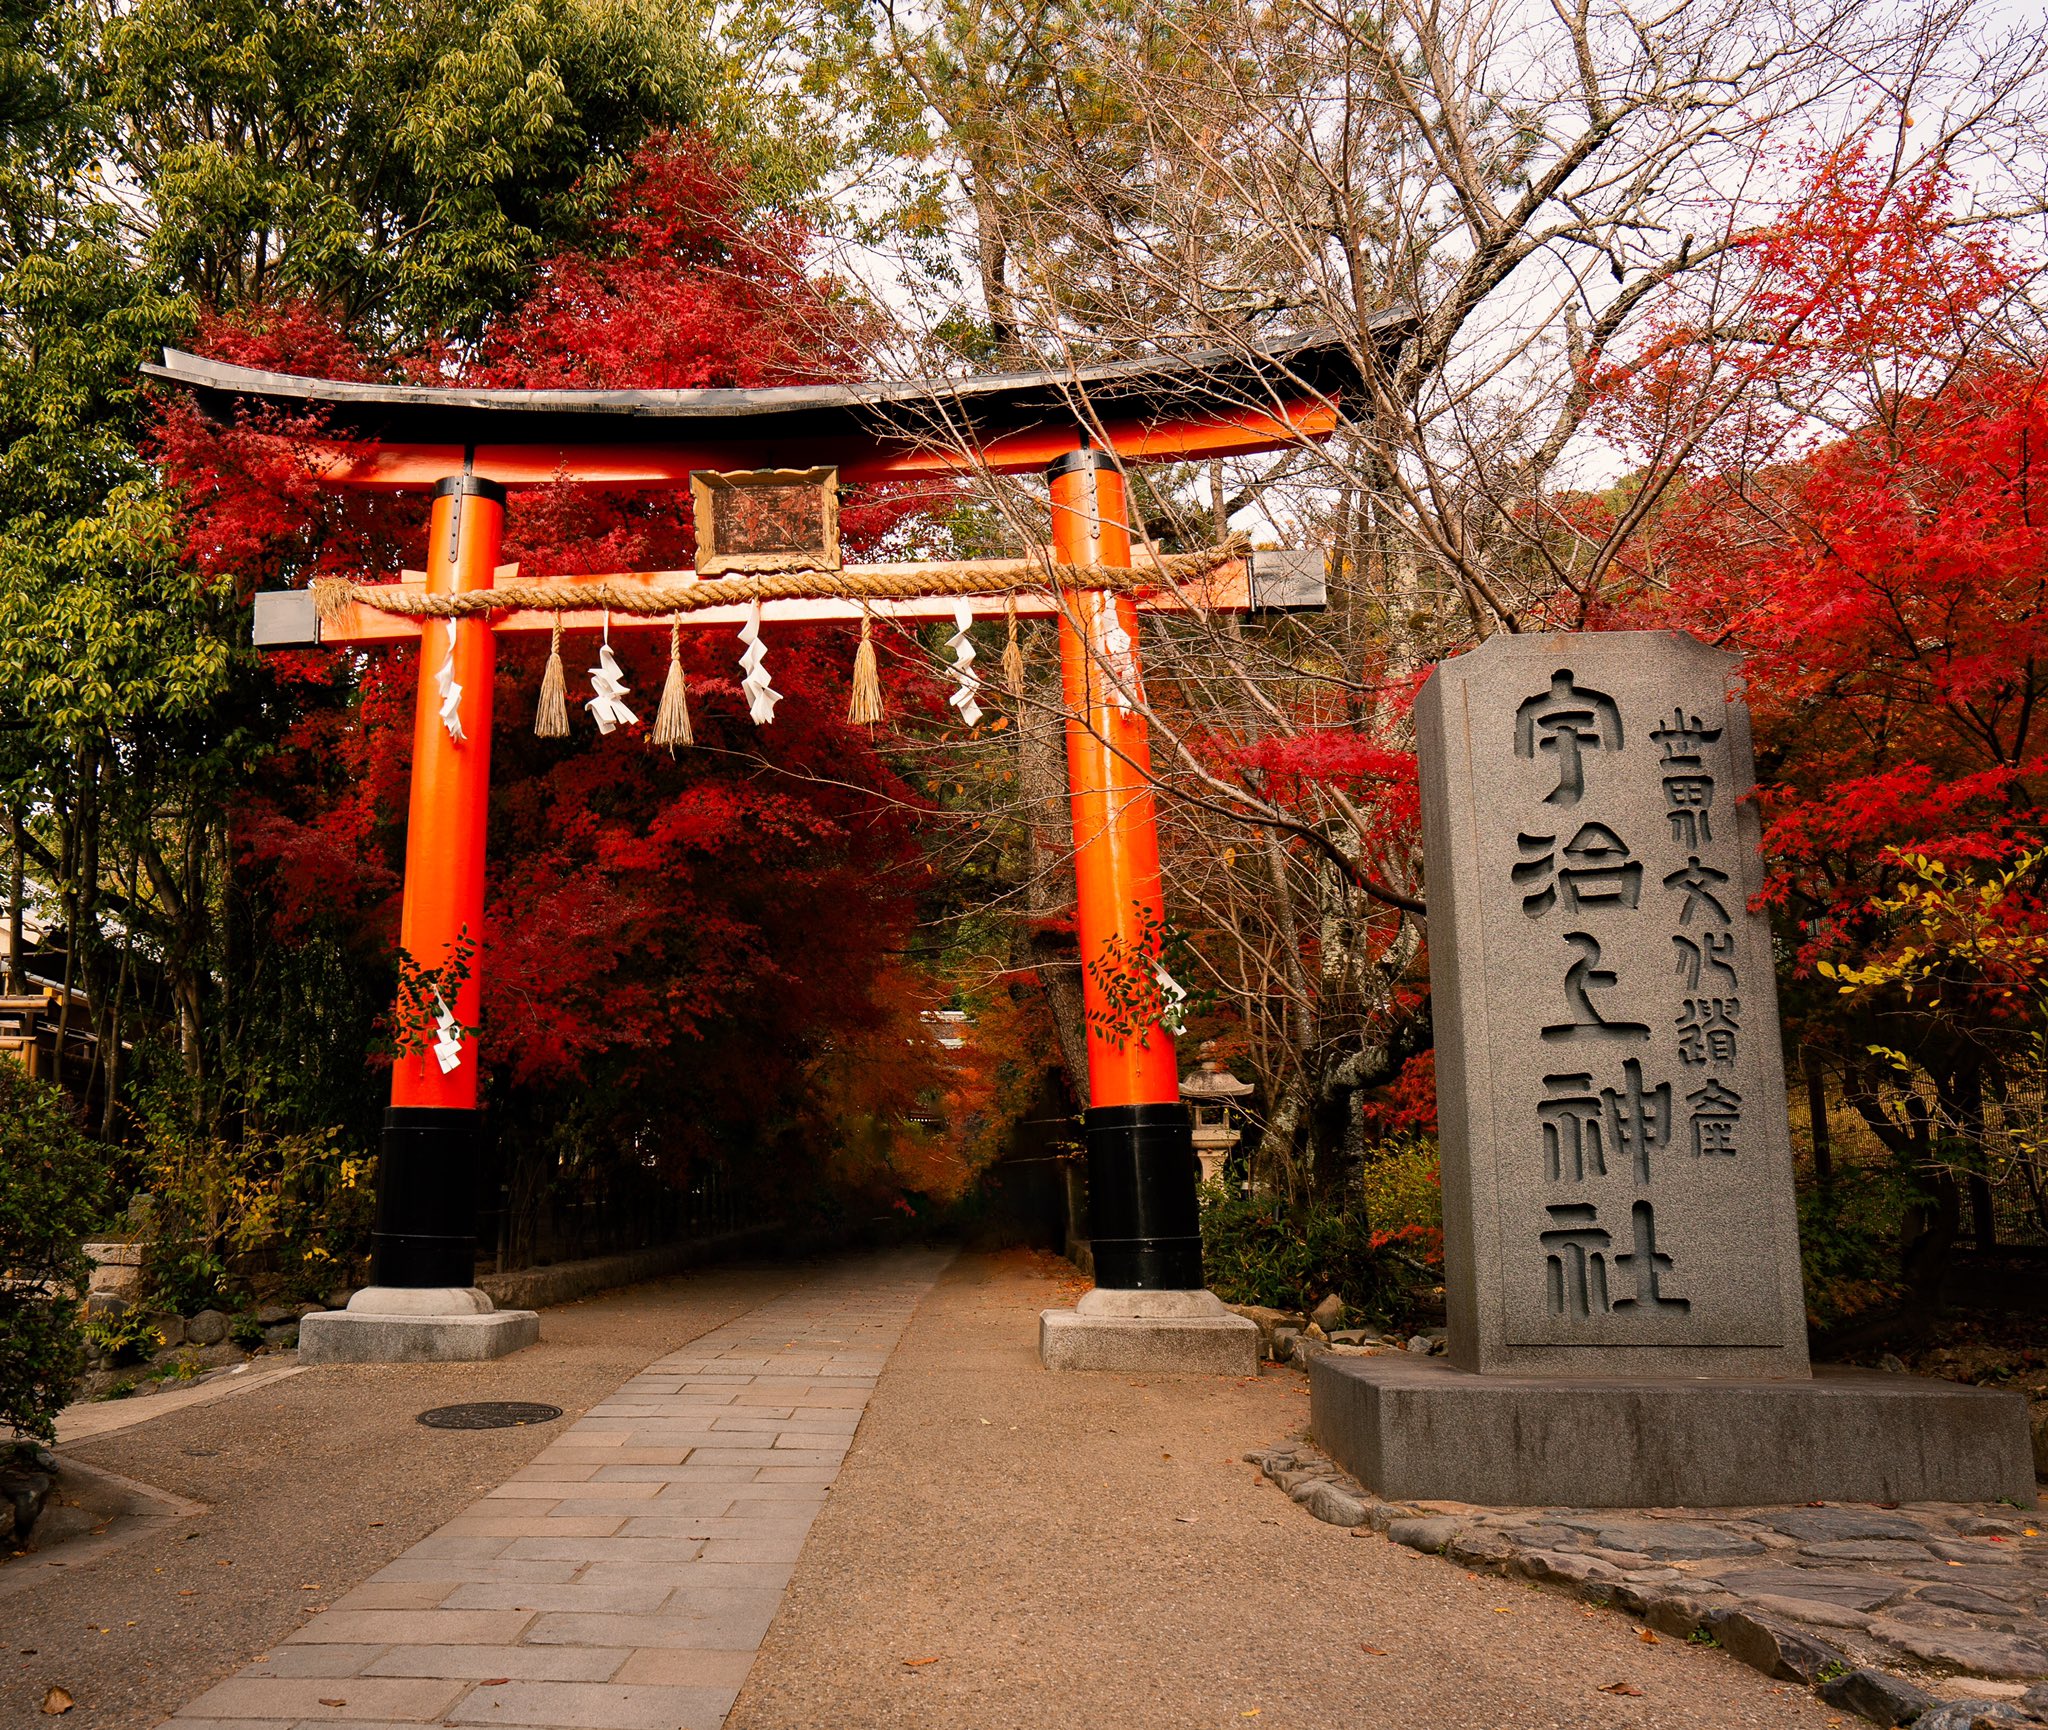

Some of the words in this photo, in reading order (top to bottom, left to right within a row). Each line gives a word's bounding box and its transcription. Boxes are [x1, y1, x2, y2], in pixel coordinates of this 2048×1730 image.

[1511, 668, 1692, 1322] 宇治上神社
[1649, 706, 1743, 1158] 世界文化遺産
